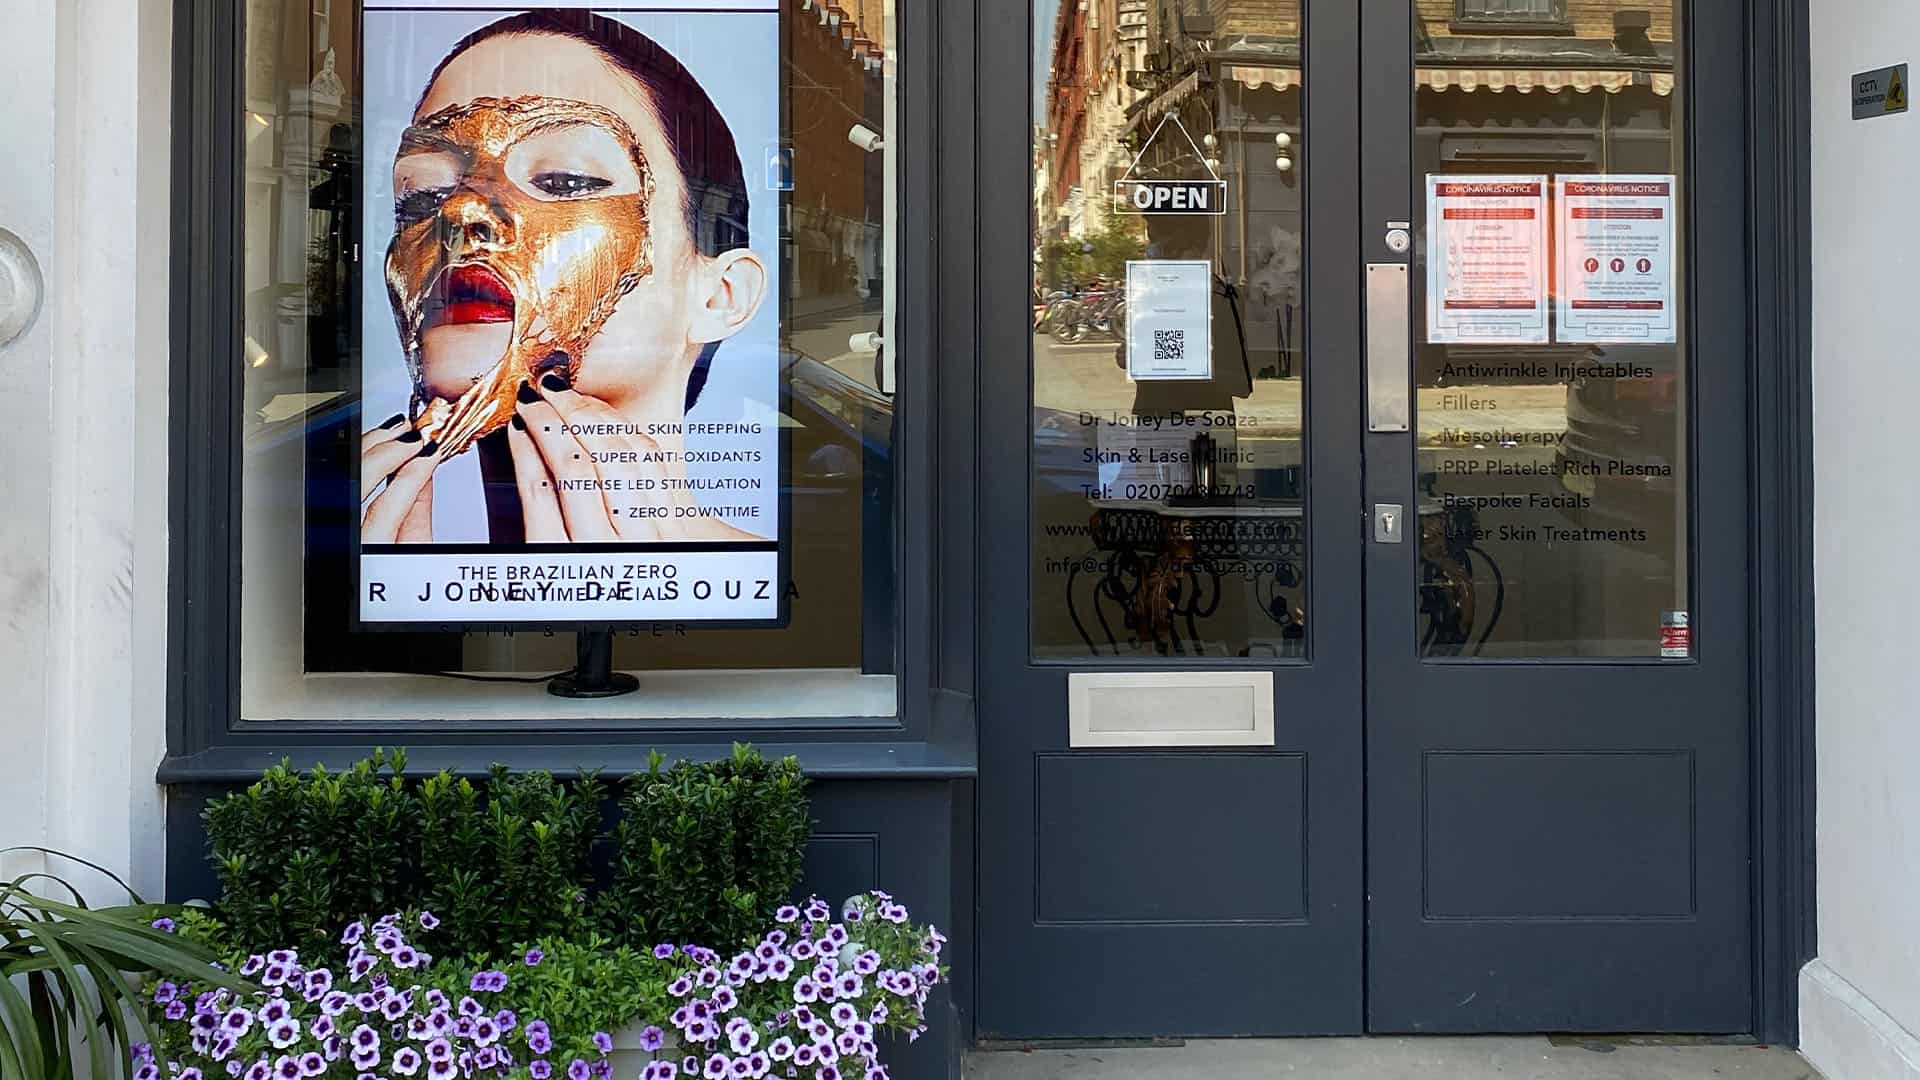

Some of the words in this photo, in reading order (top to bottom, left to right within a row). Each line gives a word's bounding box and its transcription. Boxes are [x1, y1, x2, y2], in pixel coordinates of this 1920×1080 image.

[1859, 80, 1878, 93] CCTV
[1446, 185, 1501, 193] CORONAVIRUS
[1134, 186, 1207, 209] OPEN
[1441, 363, 1548, 378] Antiwrinkle
[1555, 363, 1653, 381] Injectables
[1443, 395, 1497, 410] Fillers
[561, 424, 644, 435] POWERFUL
[648, 423, 683, 435] SKIN
[688, 423, 761, 435] PREPPING
[1079, 412, 1098, 426] Dr
[1108, 412, 1164, 431] Joney
[1170, 412, 1195, 426] De
[1203, 412, 1257, 426] Souza
[1443, 427, 1567, 445] Mesotherapy
[590, 451, 638, 463] SUPER
[643, 451, 761, 463] ANTI-OXIDANTS
[1083, 448, 1121, 463] Skin
[1128, 448, 1142, 463] &
[1444, 461, 1479, 475] PRP
[1486, 460, 1558, 476] Platelet
[1564, 460, 1600, 475] Rich
[1608, 460, 1671, 476] Plasma
[557, 479, 622, 491] INTENSE
[628, 479, 655, 490] LED
[660, 478, 761, 490] STIMULATION
[1081, 484, 1112, 499] Tel:
[1444, 493, 1522, 513] Bespoke
[1529, 493, 1590, 508] Facials
[629, 506, 668, 518] ZERO
[675, 506, 760, 518] DOWNTIME
[1499, 526, 1536, 541] Skin
[1543, 526, 1646, 541] Treatments
[458, 566, 497, 580] THE
[506, 565, 614, 580] BRAZILIAN
[623, 564, 677, 579] ZERO
[418, 581, 557, 602] JONEY
[585, 580, 632, 601] DE
[665, 580, 800, 600] SOUZA
[469, 588, 586, 602] DOWNTIME
[440, 624, 513, 638] SKIN
[543, 623, 555, 637] &
[582, 623, 687, 637] LASER
